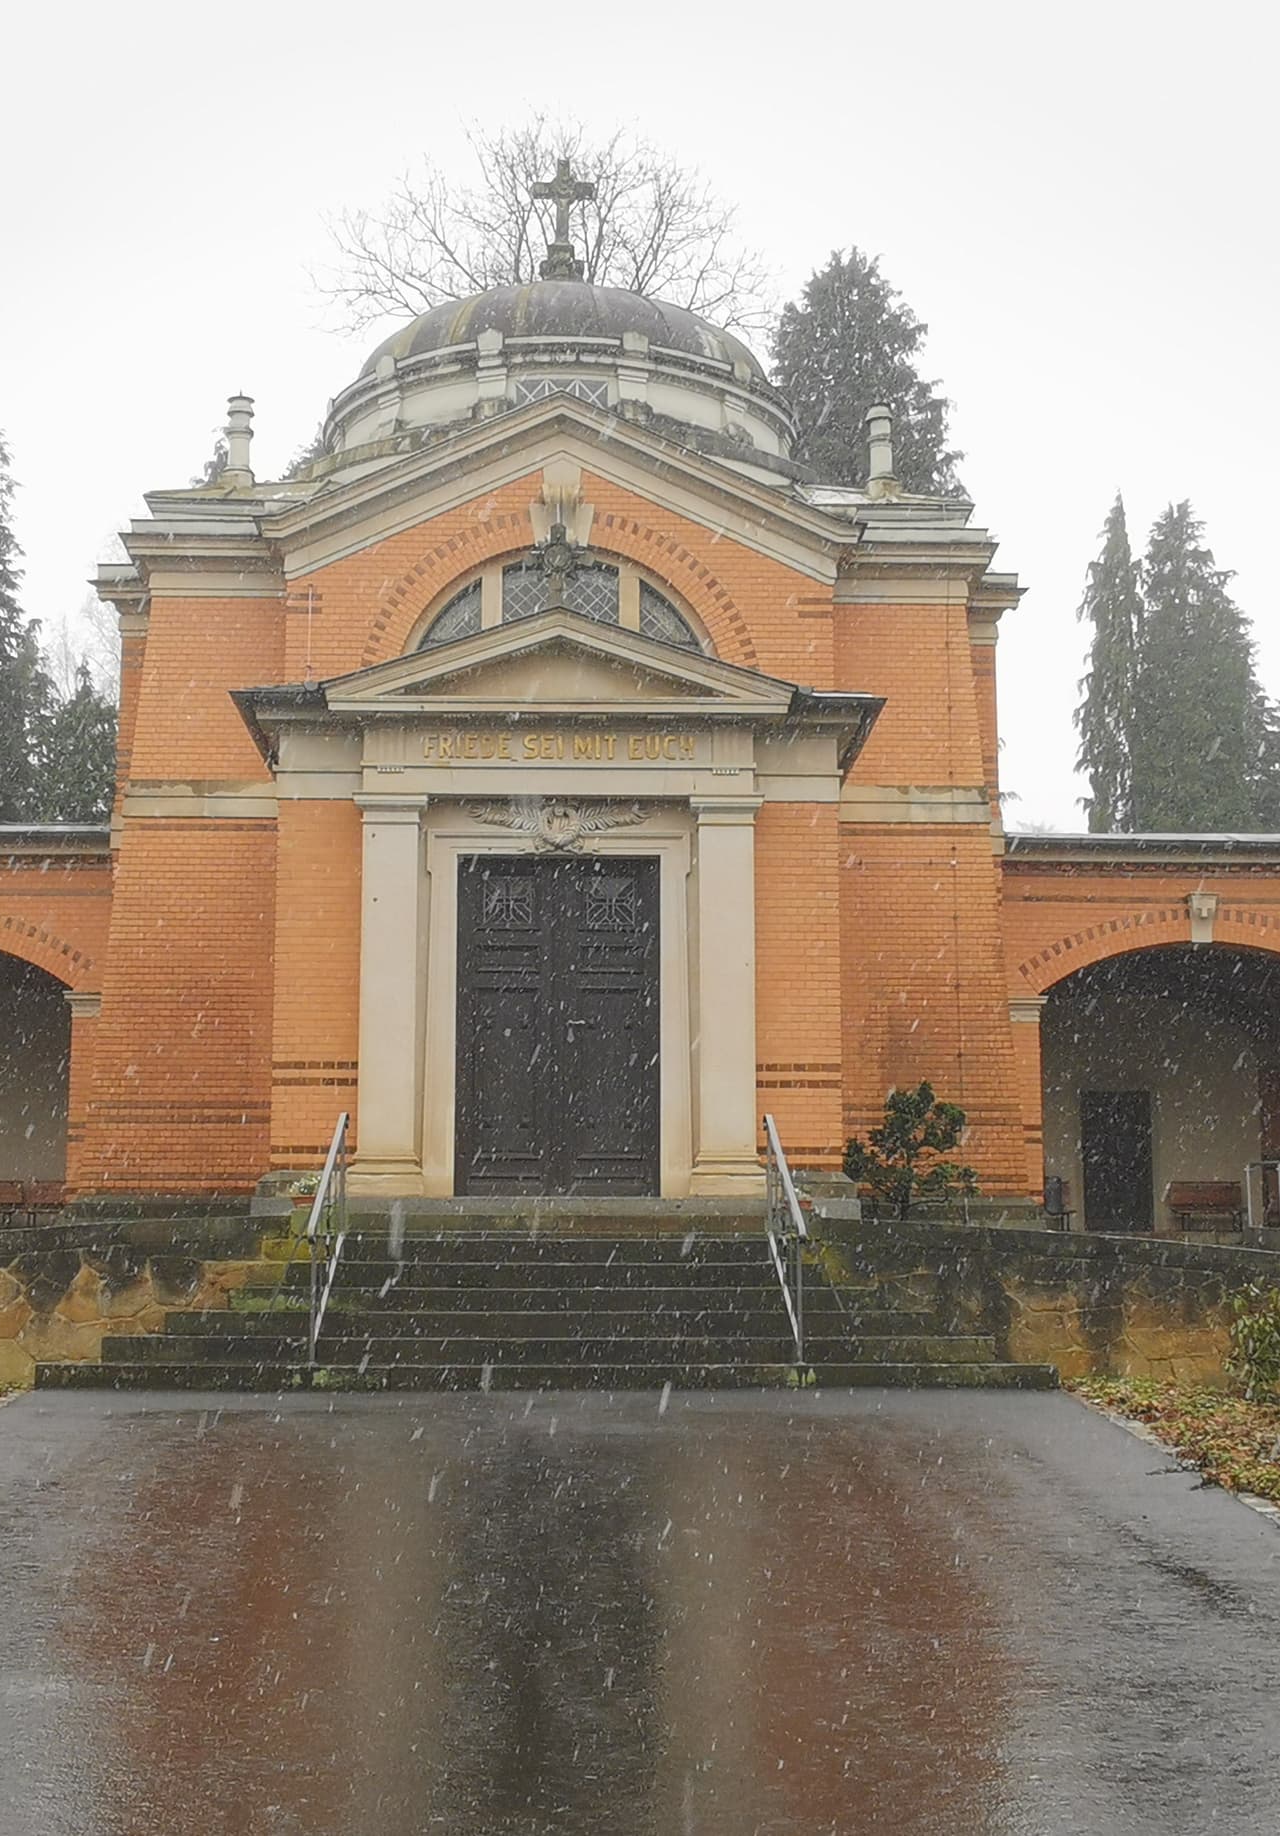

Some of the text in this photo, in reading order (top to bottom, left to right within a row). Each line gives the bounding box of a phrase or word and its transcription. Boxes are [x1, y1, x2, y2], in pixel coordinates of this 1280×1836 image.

[423, 734, 696, 760] FRIEDE SEI MIT EUCH
